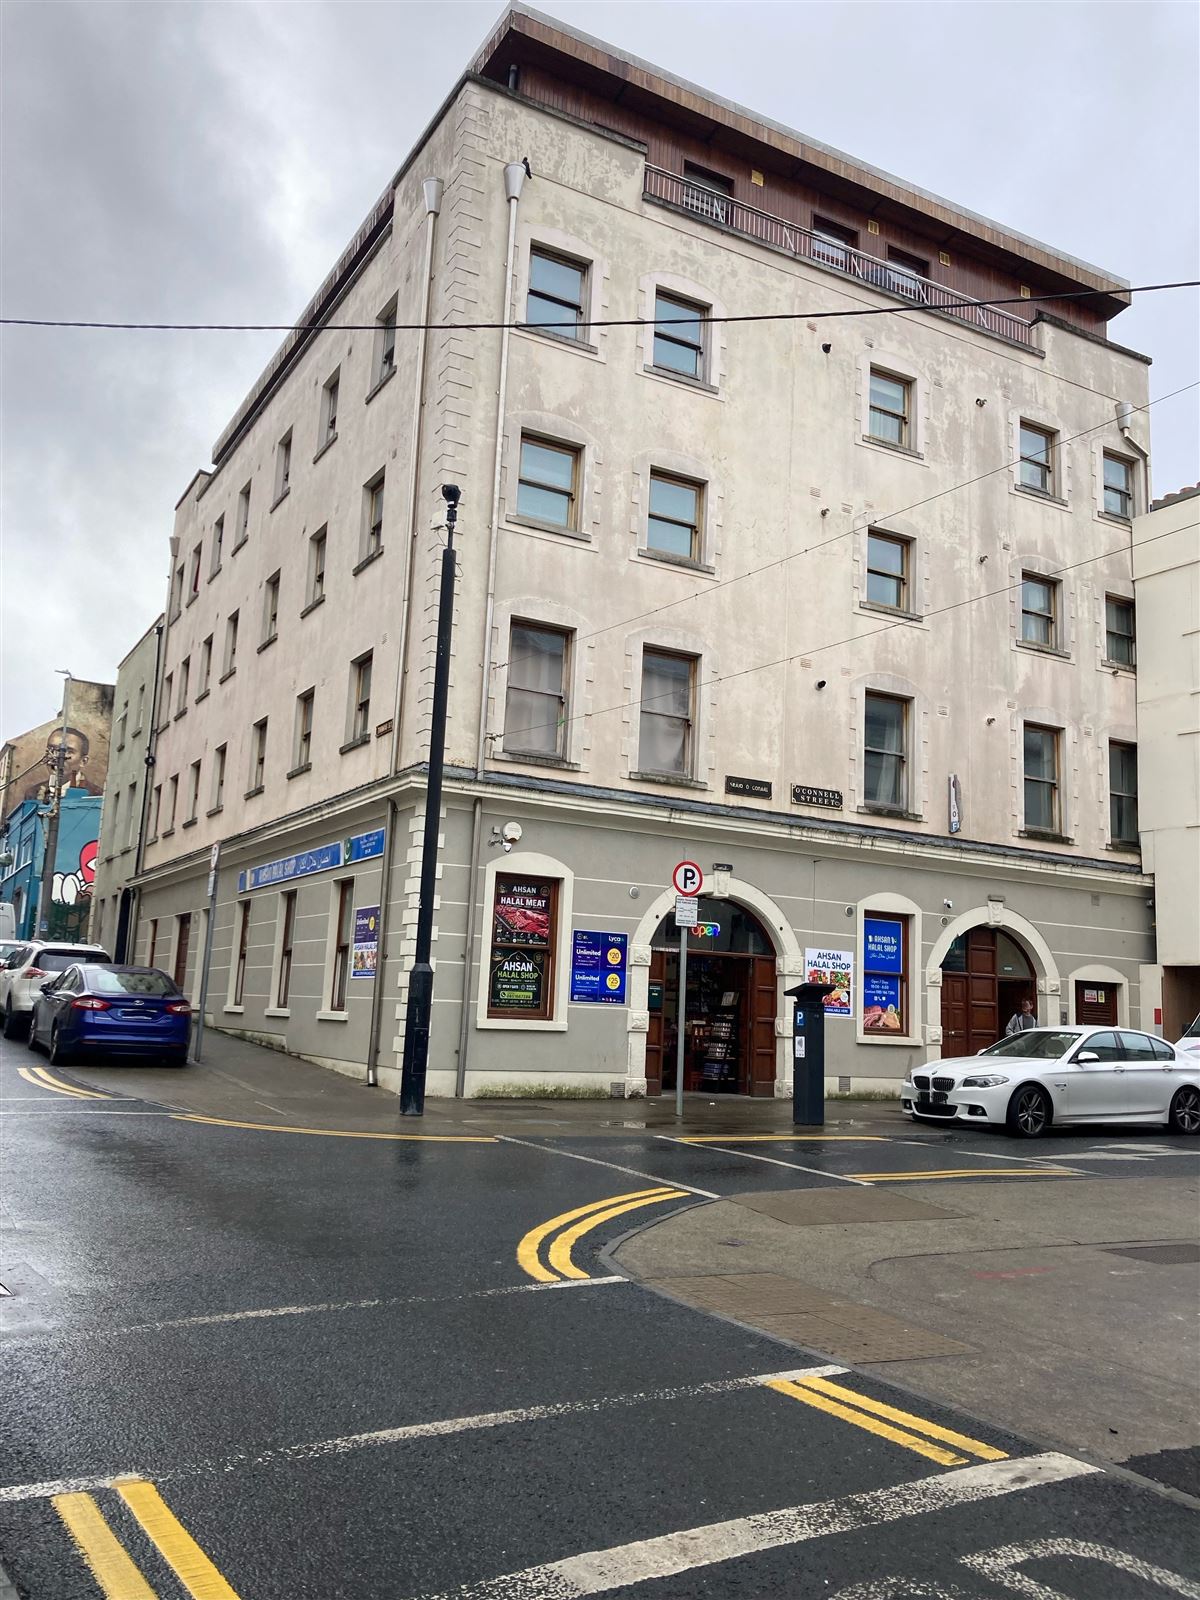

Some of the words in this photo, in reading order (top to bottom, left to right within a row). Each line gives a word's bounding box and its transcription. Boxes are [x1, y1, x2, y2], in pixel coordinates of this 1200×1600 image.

[795, 787, 840, 799] O'CONNELL
[800, 795, 836, 806] STREET
[512, 886, 536, 894] AHSAN
[500, 897, 524, 906] HALAL
[526, 899, 546, 907] MEAT
[884, 945, 897, 953] SHOP
[817, 952, 842, 961] AHSAN
[503, 961, 533, 972] AHSAN
[807, 960, 830, 969] HALAL
[832, 962, 851, 971] SHOP
[497, 971, 520, 979] HALAL
[520, 971, 538, 980] SHOP
